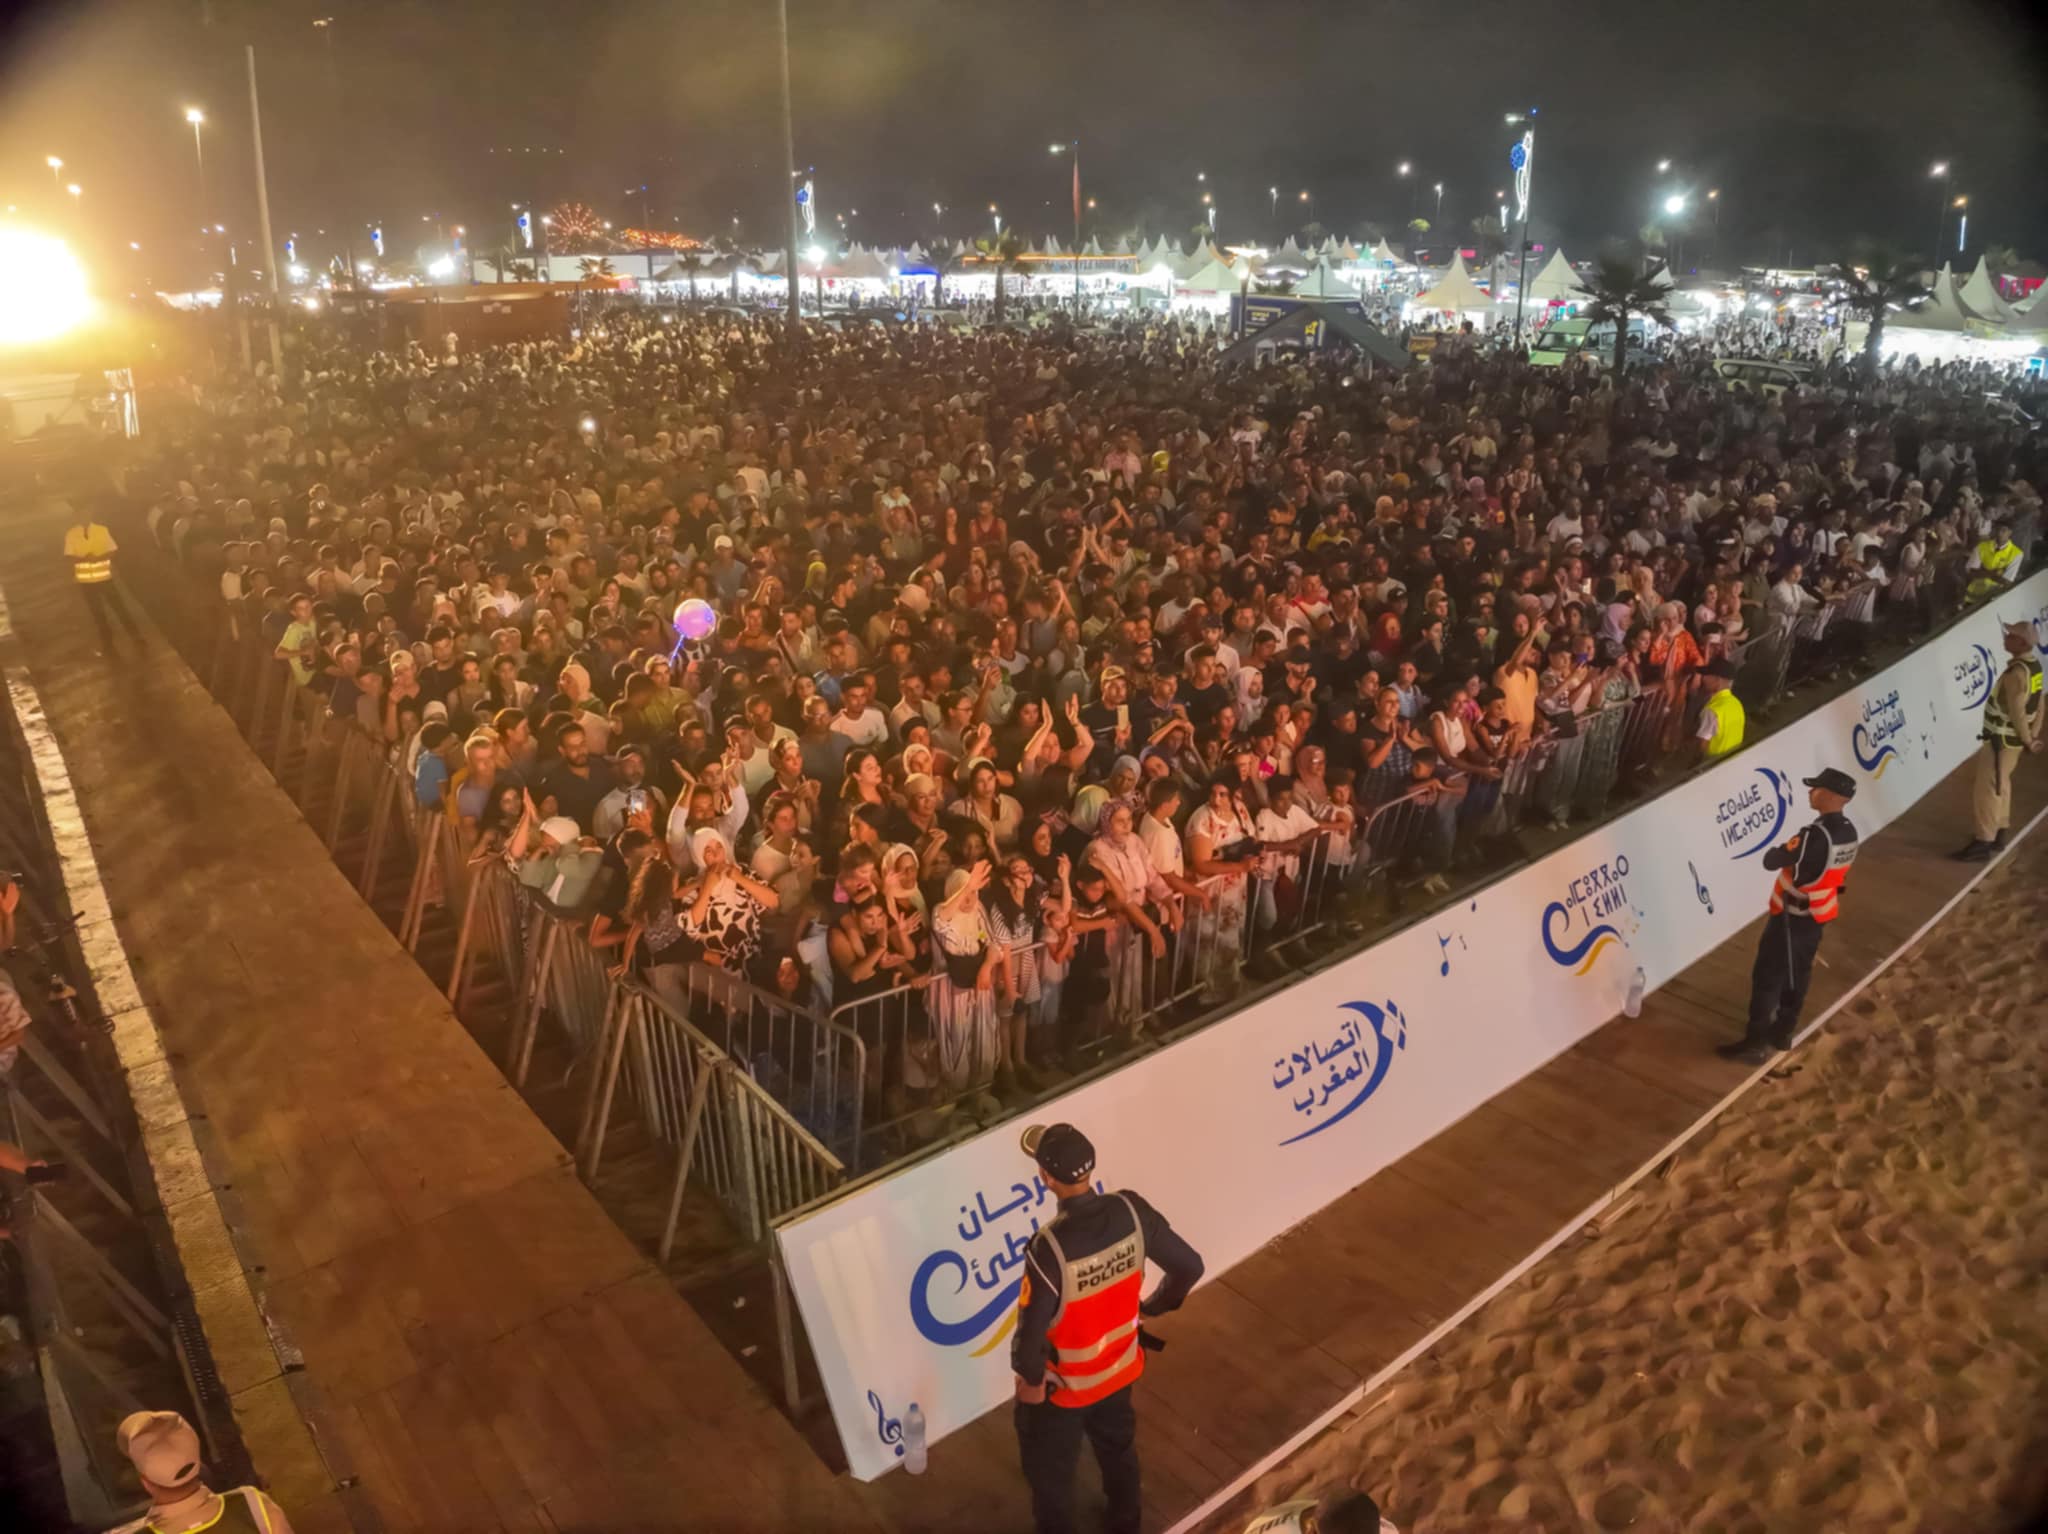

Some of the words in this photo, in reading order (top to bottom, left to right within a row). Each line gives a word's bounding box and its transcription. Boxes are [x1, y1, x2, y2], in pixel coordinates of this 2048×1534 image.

[1862, 689, 1900, 722] مهرجان
[1273, 1019, 1362, 1090] اتصالات
[1293, 1047, 1370, 1116] المغرب
[958, 1175, 1049, 1241] رجان
[1077, 1243, 1136, 1278] الشرطة
[1077, 1255, 1137, 1292] POLICE
